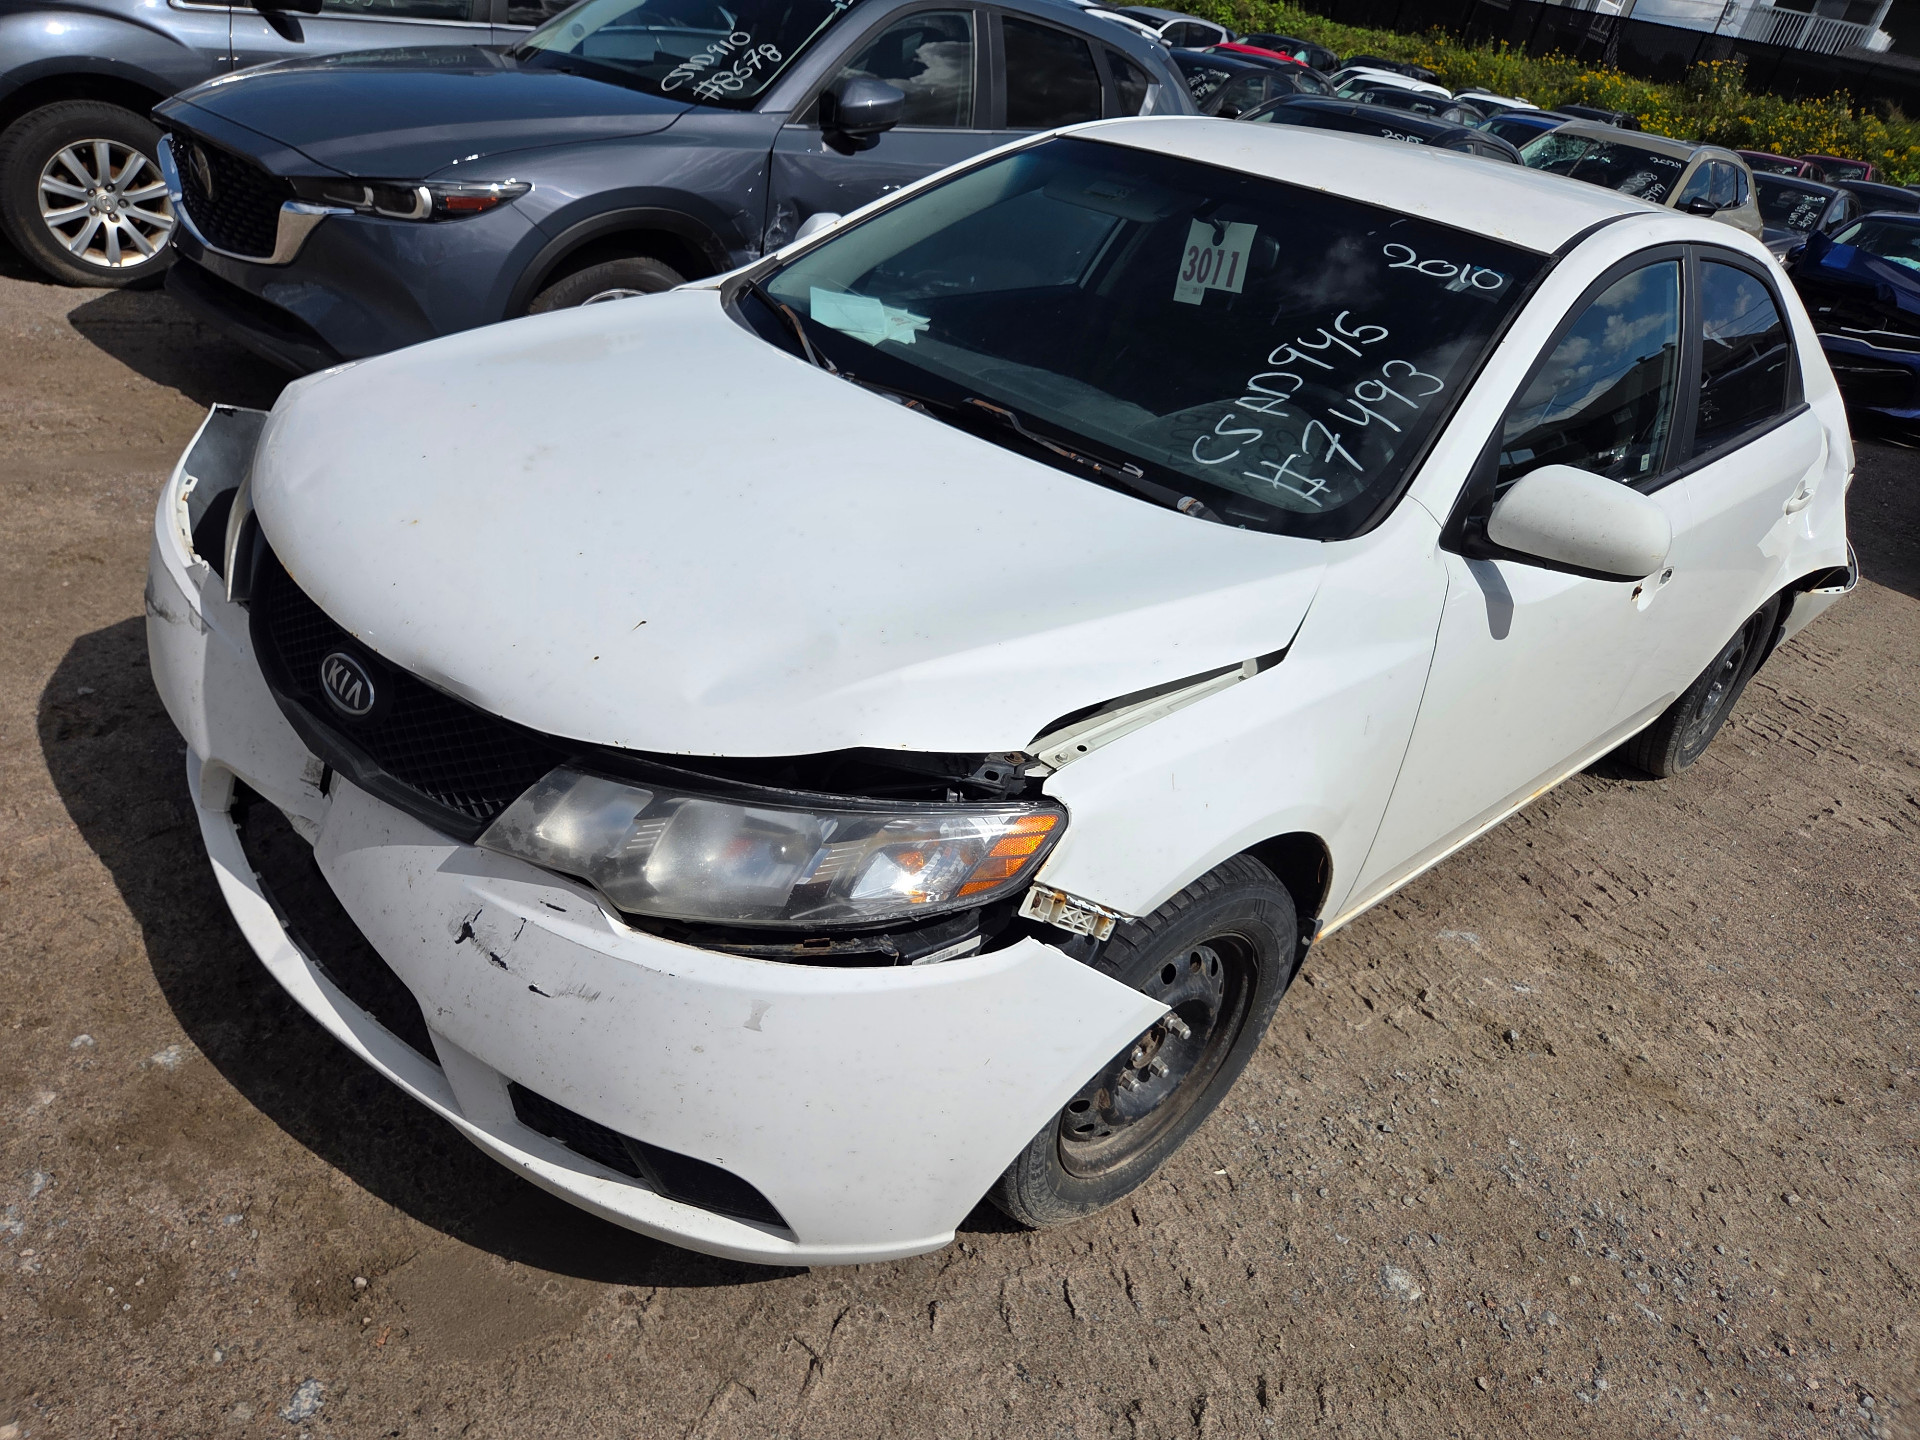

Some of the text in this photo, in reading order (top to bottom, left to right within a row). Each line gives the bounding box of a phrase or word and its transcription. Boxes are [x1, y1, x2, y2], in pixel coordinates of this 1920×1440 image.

[1182, 245, 1241, 288] 3011
[1383, 243, 1504, 290] 2010
[1192, 310, 1389, 465] CSAD945
[1243, 359, 1445, 507] #7493
[327, 658, 363, 709] KIA
